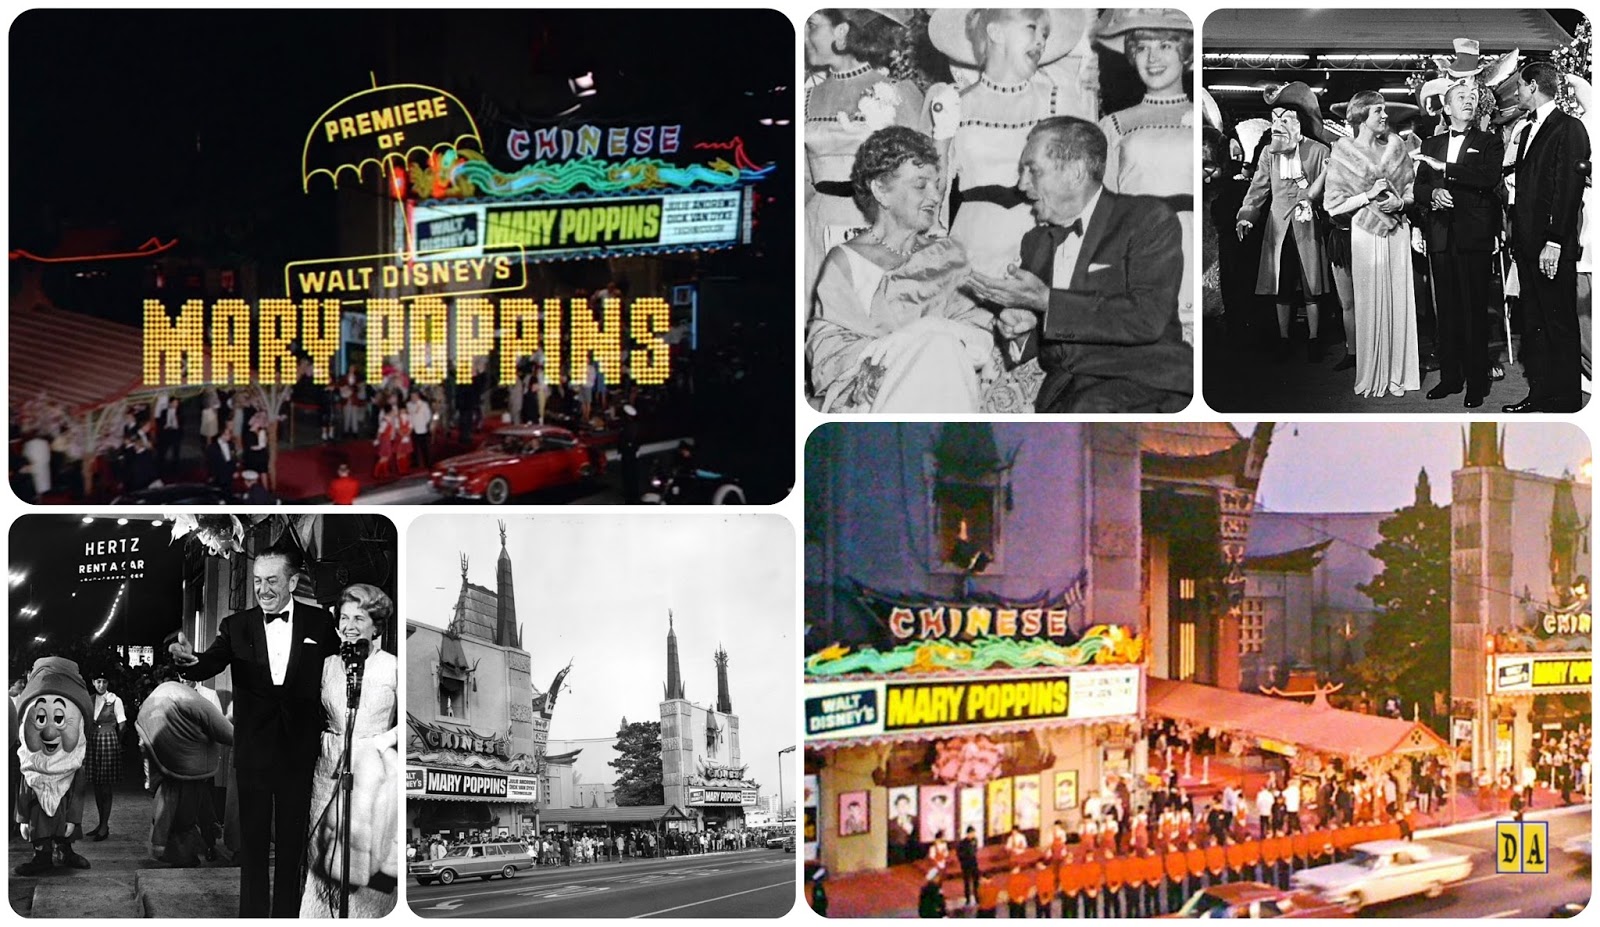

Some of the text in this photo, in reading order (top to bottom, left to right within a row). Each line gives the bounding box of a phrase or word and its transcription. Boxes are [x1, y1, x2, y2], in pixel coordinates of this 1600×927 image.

[324, 96, 448, 143] PREMIERE
[377, 132, 405, 150] OF
[507, 124, 681, 160] CHINESE
[430, 217, 465, 236] WALT
[485, 203, 660, 249] MARY POPPINS
[298, 256, 511, 294] WALT DISNEY'S
[142, 298, 671, 386] MARY POPPINS
[85, 537, 139, 556] HERTZ
[78, 562, 107, 574] RENT
[109, 561, 118, 572] A
[889, 607, 1068, 638] CHINESE
[821, 694, 861, 714] WALT
[887, 685, 965, 727] MARY
[966, 680, 1069, 722] POPPINS
[809, 706, 875, 731] DISNEY'S
[427, 729, 506, 757] CHINESE
[406, 772, 417, 780] ALT
[428, 772, 507, 795] MARY POPPINS
